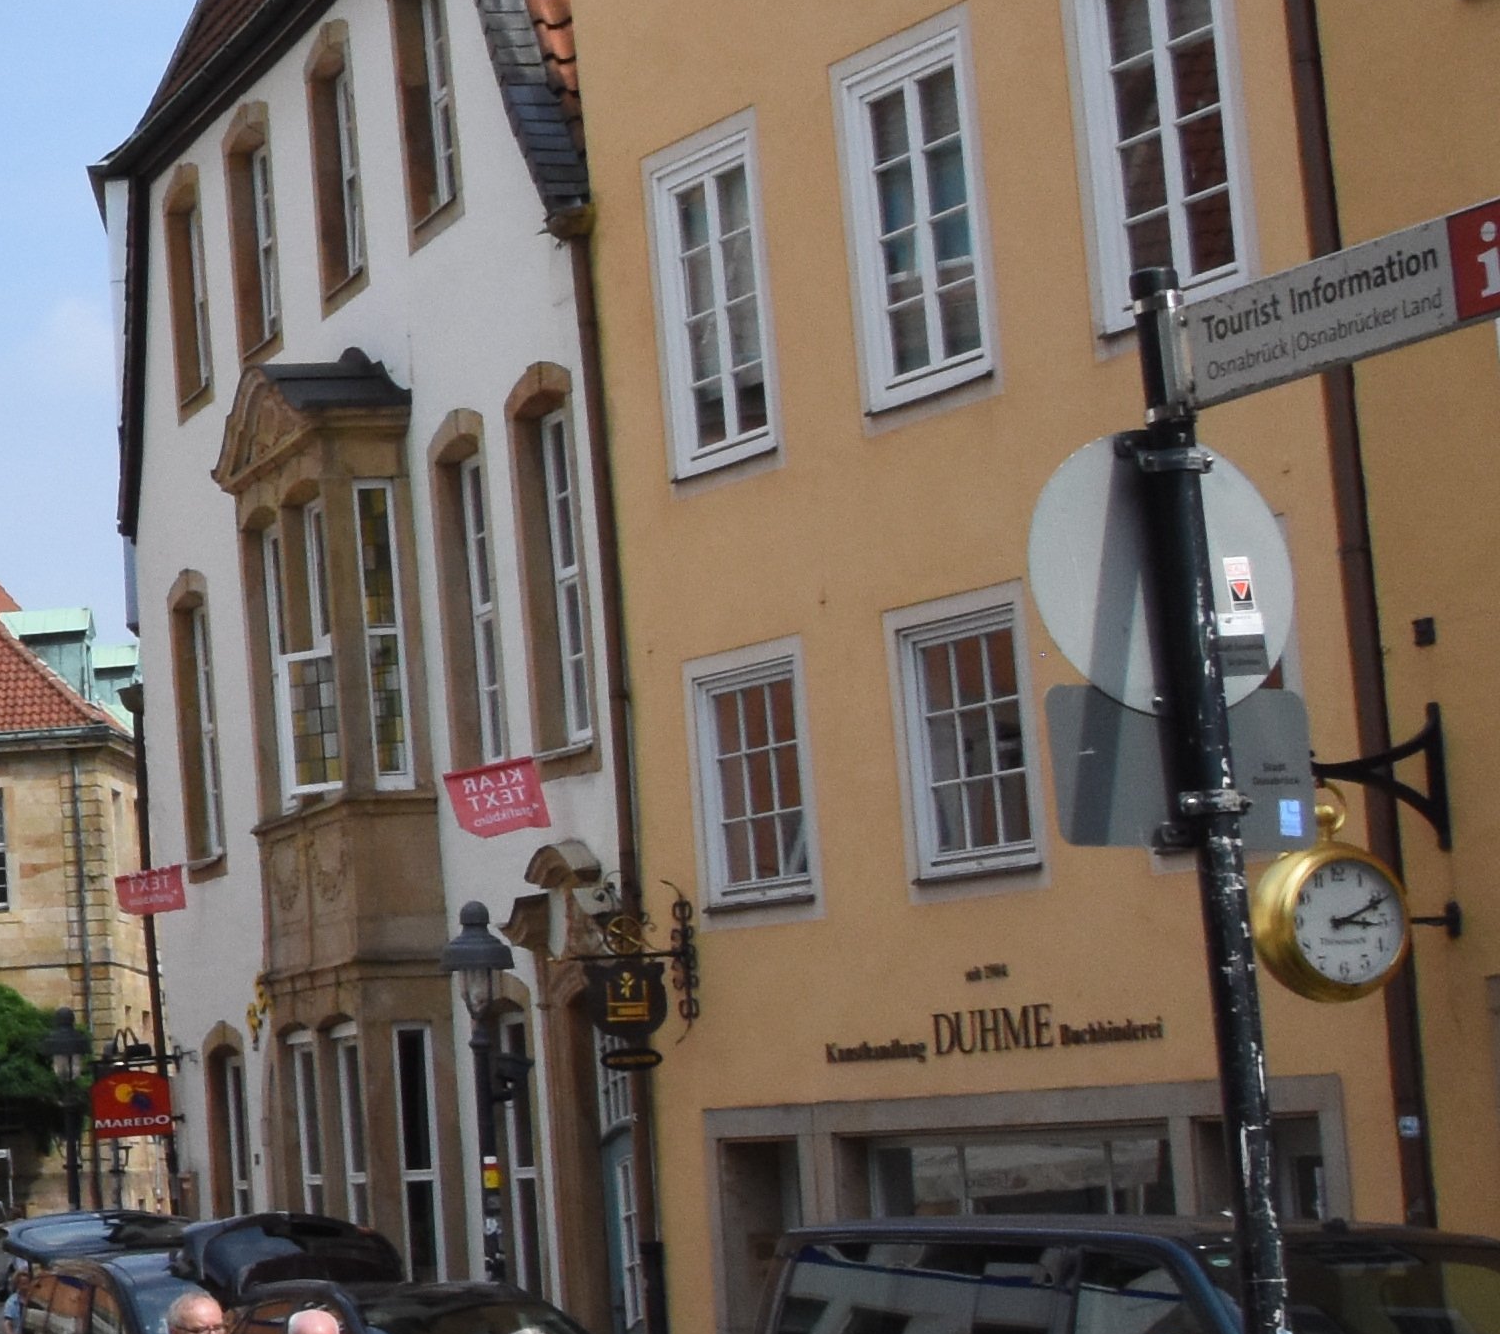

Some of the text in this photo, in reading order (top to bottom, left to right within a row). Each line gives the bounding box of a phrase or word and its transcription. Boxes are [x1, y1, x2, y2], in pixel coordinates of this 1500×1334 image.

[1202, 247, 1438, 343] Tourist Information
[1207, 338, 1288, 380] Osnabrück
[1297, 308, 1398, 353] Osnabrücker
[1402, 288, 1442, 319] Land
[932, 1003, 1054, 1055] DUHME
[1059, 1016, 1164, 1046] Buchbinderei
[94, 1114, 171, 1131] MAREDO
